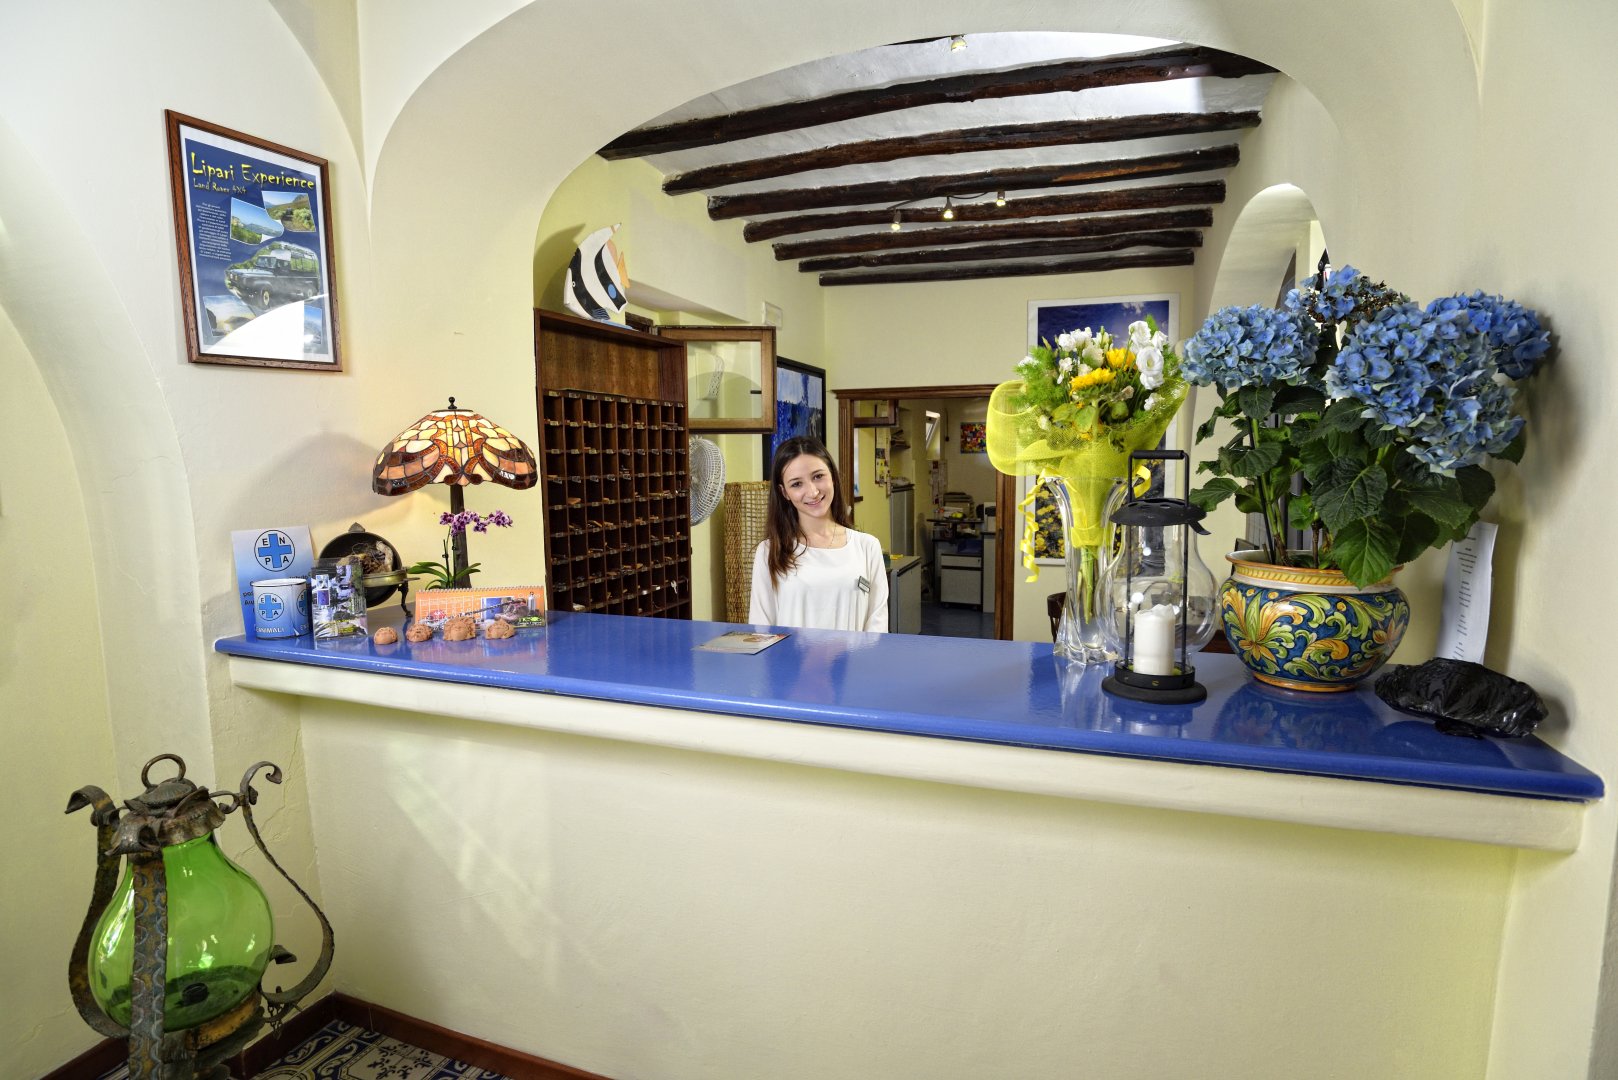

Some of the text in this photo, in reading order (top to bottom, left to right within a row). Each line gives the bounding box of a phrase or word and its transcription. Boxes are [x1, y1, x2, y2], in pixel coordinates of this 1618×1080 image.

[191, 152, 315, 189] Lipari Experience
[193, 177, 210, 190] Land
[212, 182, 230, 193] Rover
[263, 537, 286, 546] E N
[265, 555, 290, 565] P A
